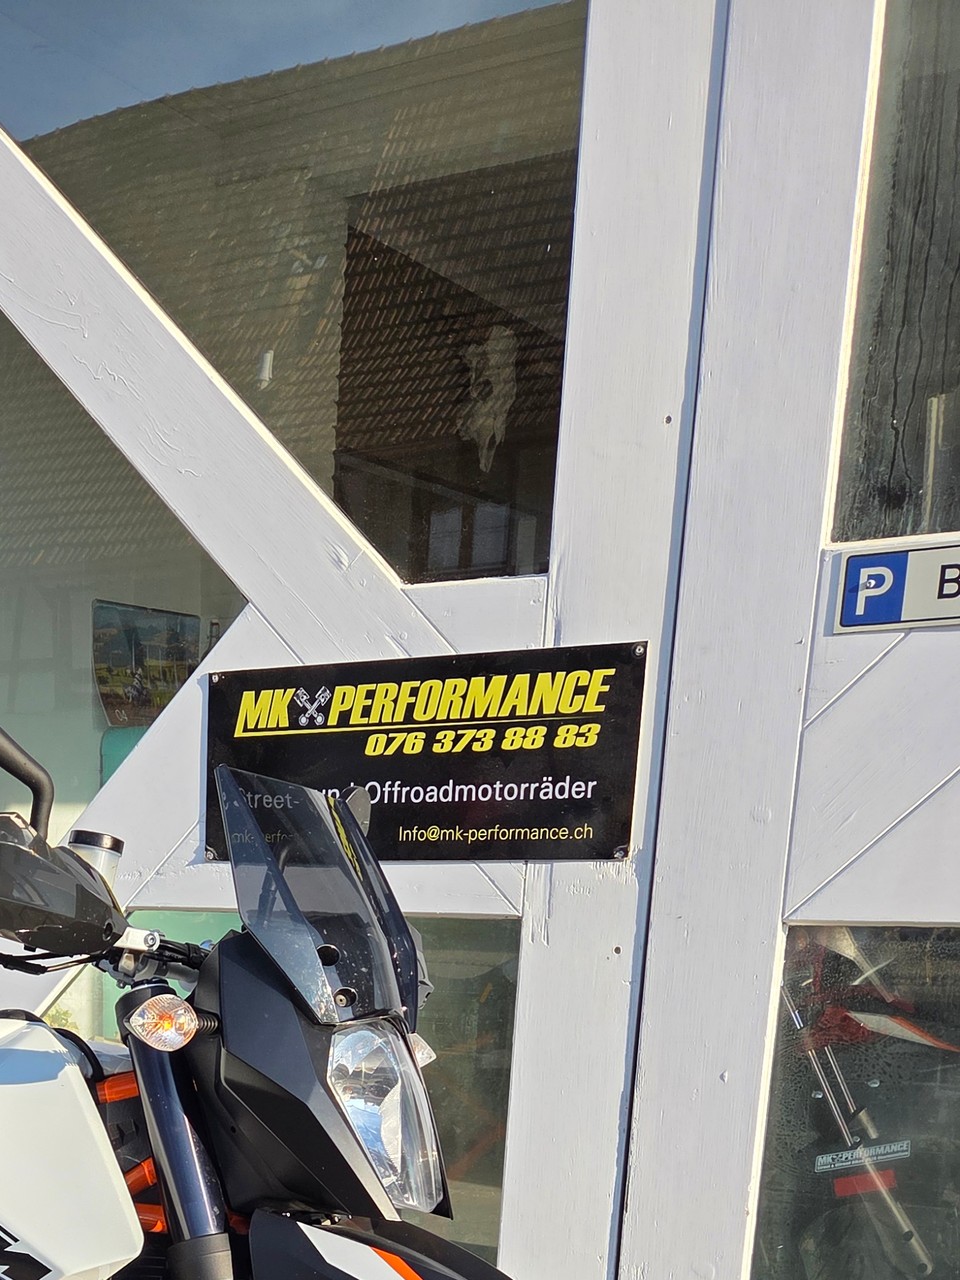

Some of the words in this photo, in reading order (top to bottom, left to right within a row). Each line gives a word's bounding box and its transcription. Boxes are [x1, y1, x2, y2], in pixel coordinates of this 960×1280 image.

[855, 566, 894, 615] P
[236, 688, 296, 733] MK
[327, 668, 616, 726] PERFORMANCE
[364, 731, 427, 756] 076
[432, 728, 497, 754] 373
[501, 725, 548, 751] 88
[553, 723, 602, 748] 83
[364, 775, 598, 805] Offroadmotorräder
[398, 823, 593, 844] Info@mk-performance.ch
